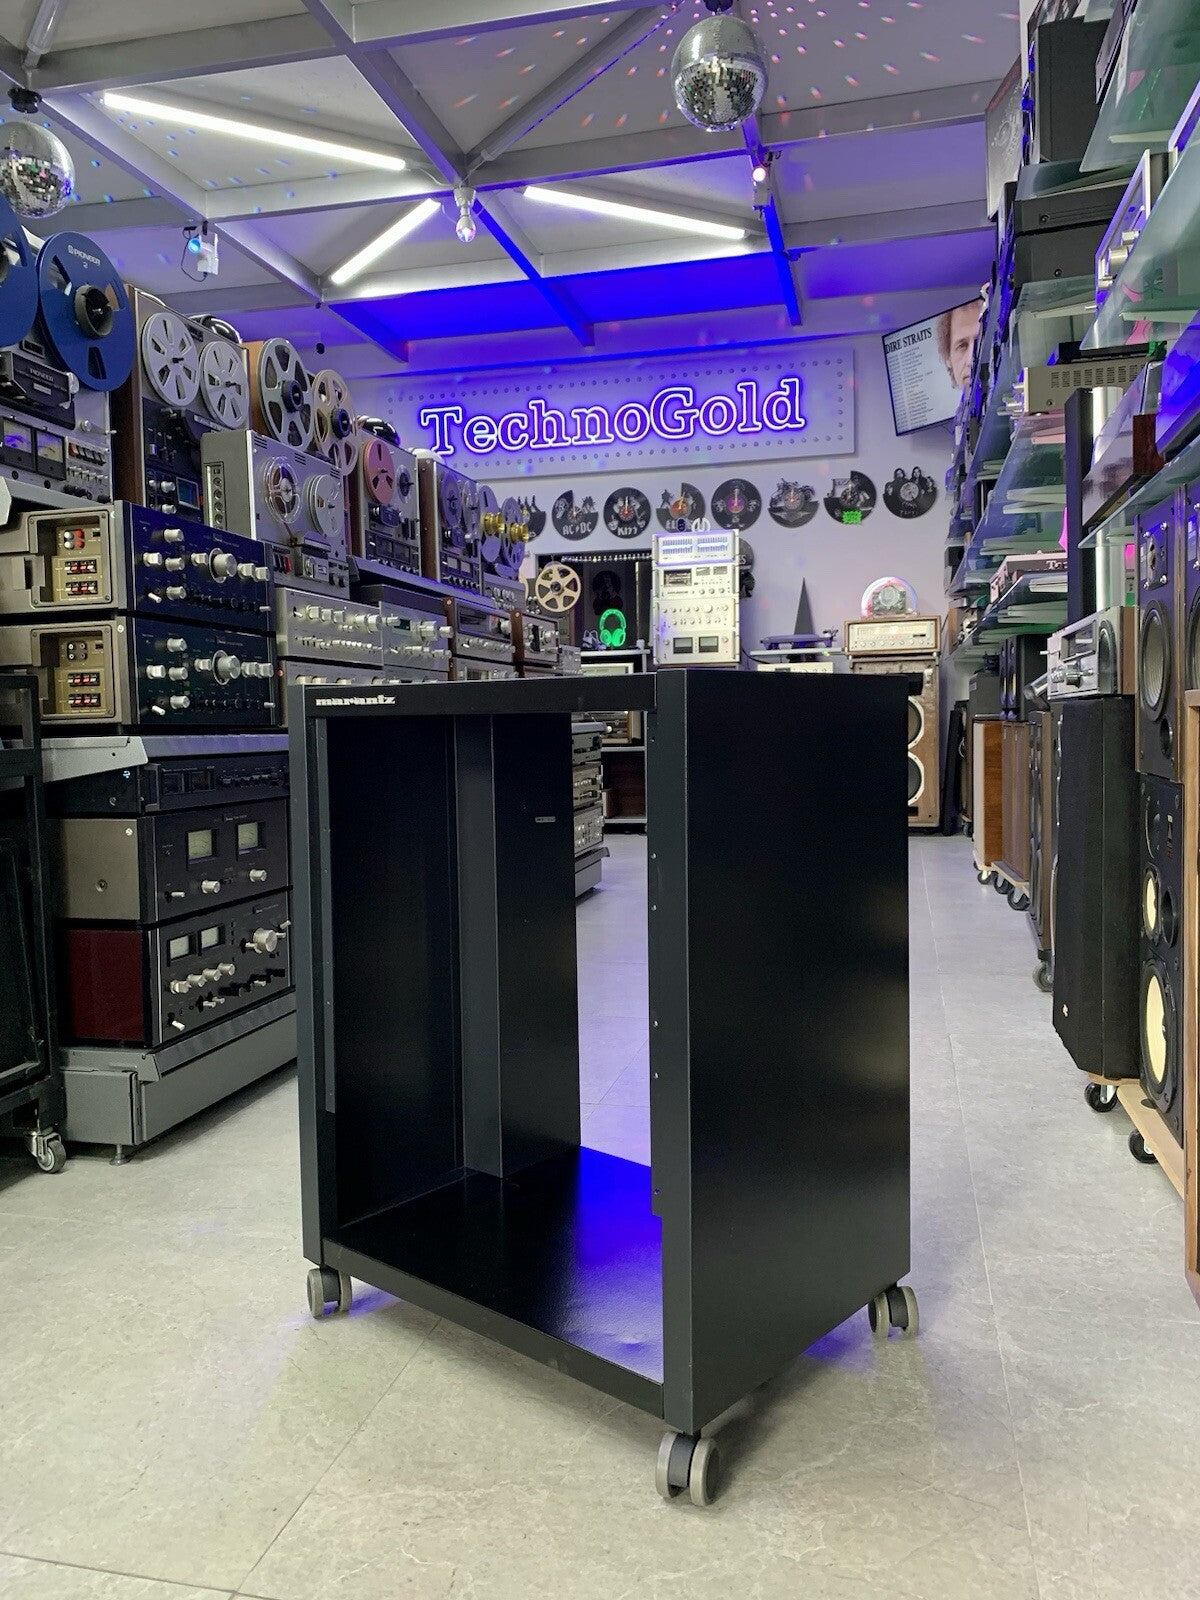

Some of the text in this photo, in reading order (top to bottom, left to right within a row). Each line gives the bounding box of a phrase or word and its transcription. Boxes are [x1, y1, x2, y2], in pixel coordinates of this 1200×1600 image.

[885, 327, 932, 354] DIRE STRAITS
[420, 378, 806, 457] TechnoGold
[315, 694, 396, 706] marantz
